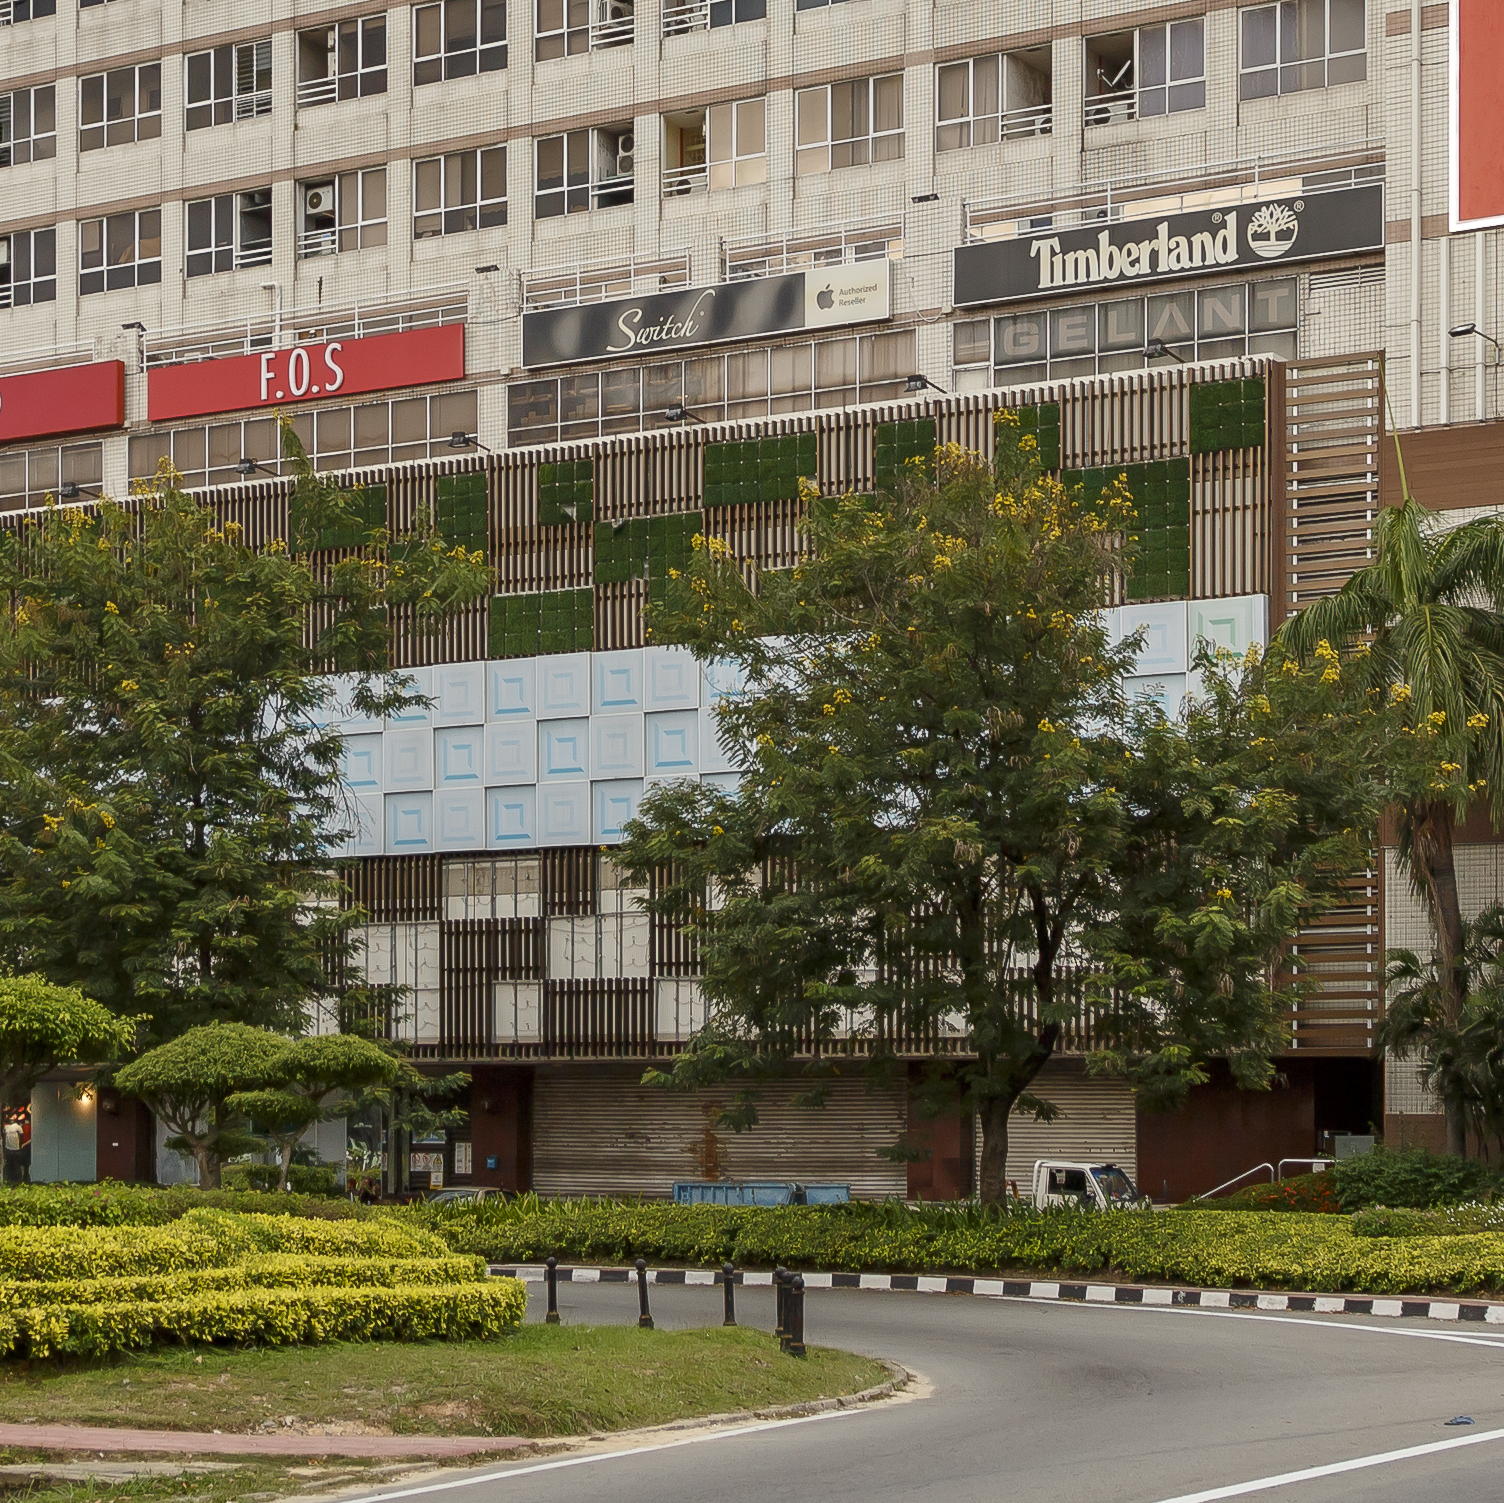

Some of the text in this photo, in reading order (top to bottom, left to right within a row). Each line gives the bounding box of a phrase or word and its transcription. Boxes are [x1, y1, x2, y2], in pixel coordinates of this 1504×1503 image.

[1030, 210, 1239, 289] Timberland
[606, 288, 716, 353] Switch
[838, 283, 878, 296] Authorized
[259, 342, 345, 401] F.O.S
